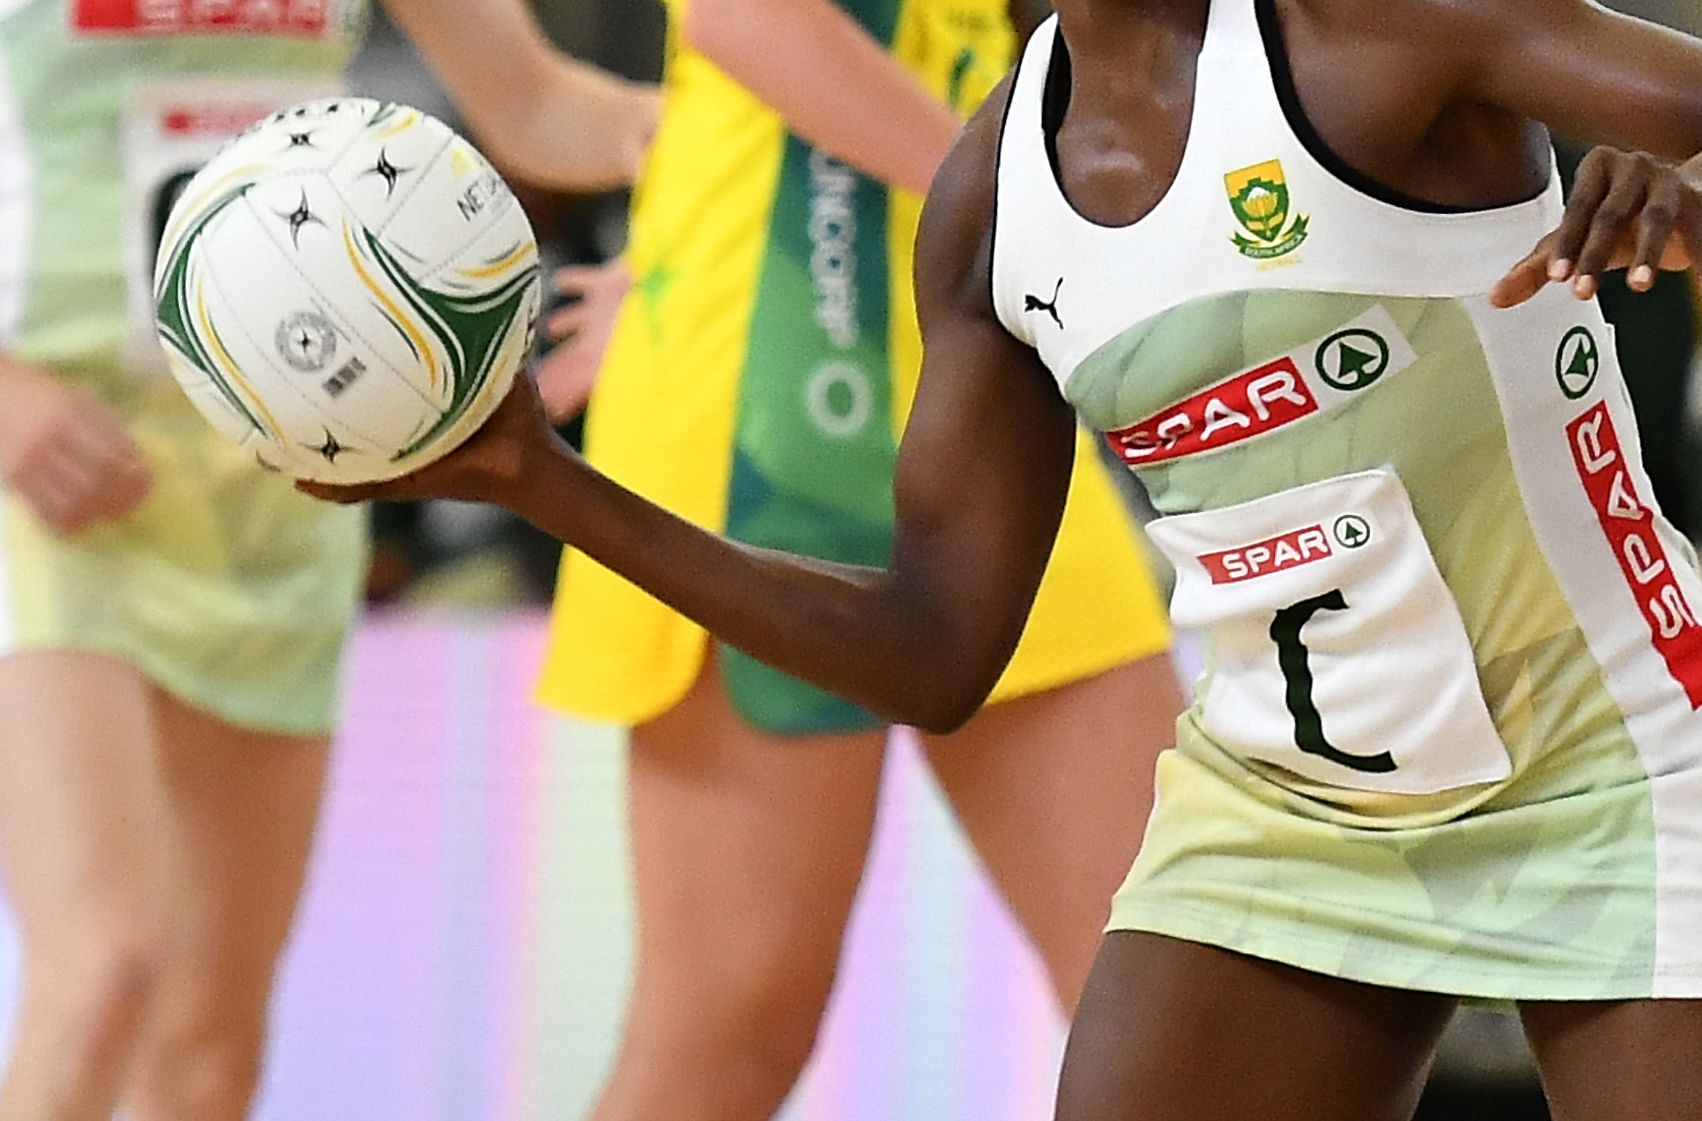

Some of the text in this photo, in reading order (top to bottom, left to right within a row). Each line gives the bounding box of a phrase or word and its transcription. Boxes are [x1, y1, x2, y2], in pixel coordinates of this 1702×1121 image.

[1120, 370, 1307, 458] SPAR
[1221, 529, 1329, 579] SPAR
[1576, 410, 1695, 640] SPAR
[1269, 588, 1399, 774] C
